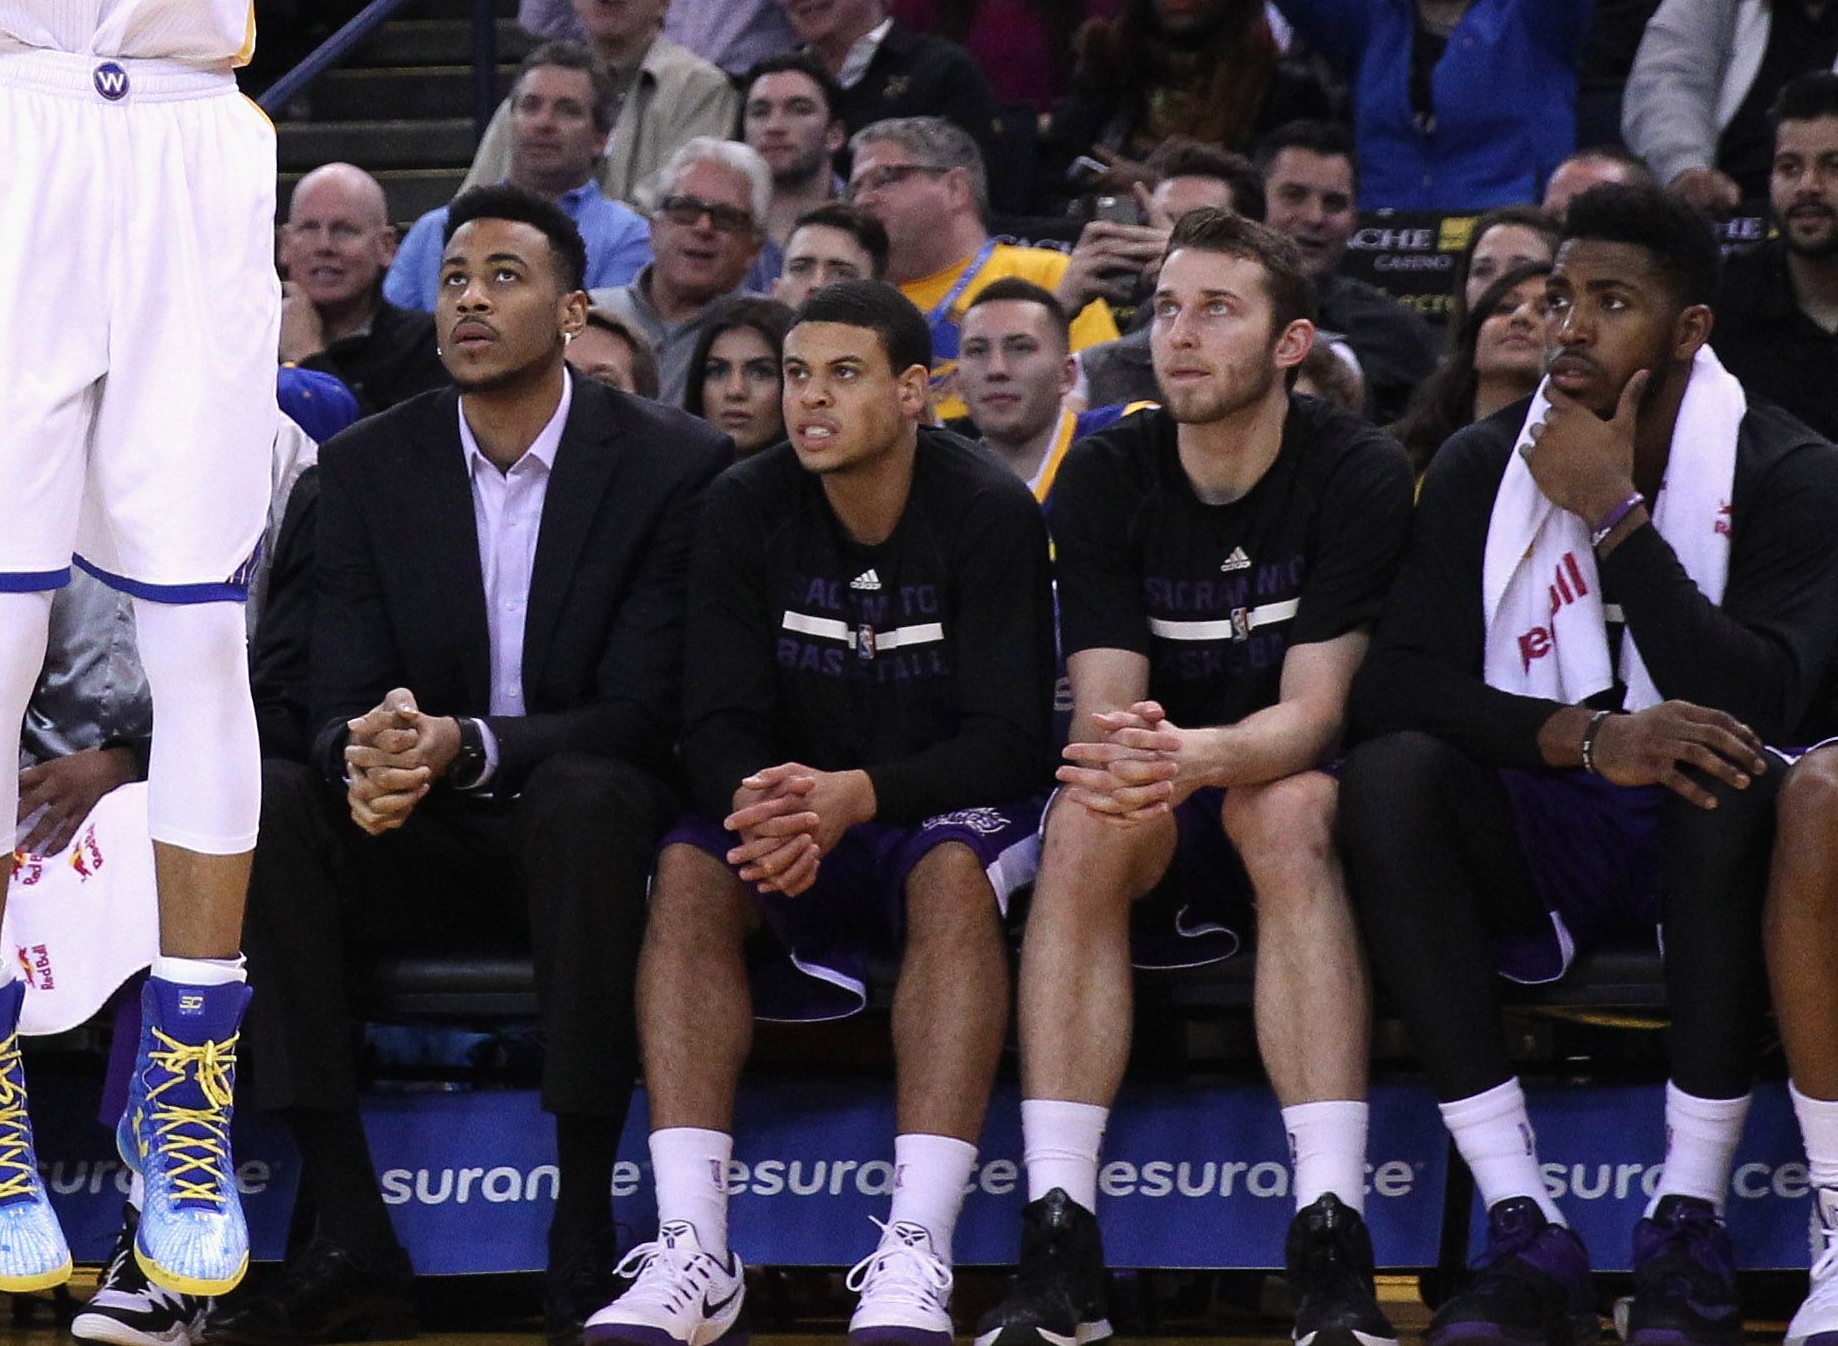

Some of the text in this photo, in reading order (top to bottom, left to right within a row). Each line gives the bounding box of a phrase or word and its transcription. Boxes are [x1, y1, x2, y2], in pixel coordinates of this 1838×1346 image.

[98, 72, 125, 92] W
[1347, 228, 1434, 251] CHE
[1098, 1160, 1414, 1197] esurae
